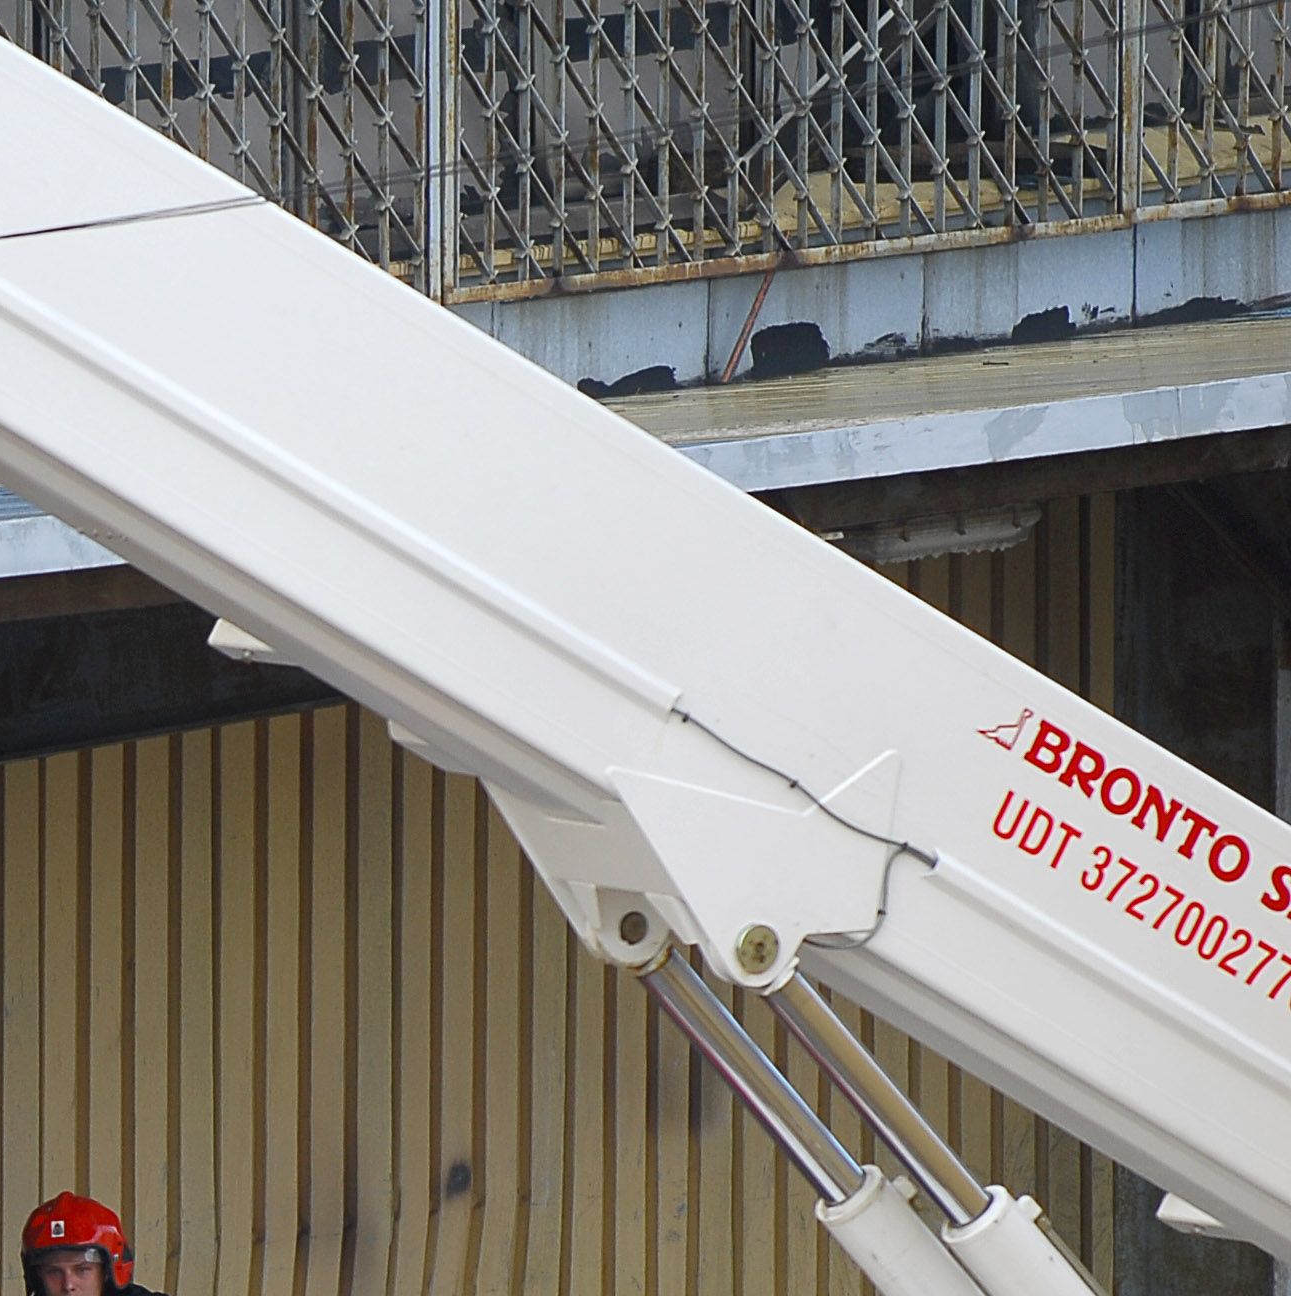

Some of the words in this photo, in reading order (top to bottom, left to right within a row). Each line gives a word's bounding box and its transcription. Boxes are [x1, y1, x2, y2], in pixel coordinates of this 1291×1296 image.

[1024, 720, 1250, 882] BRONTO
[992, 790, 1083, 869] UDT
[1081, 846, 1291, 1012] 372700277
